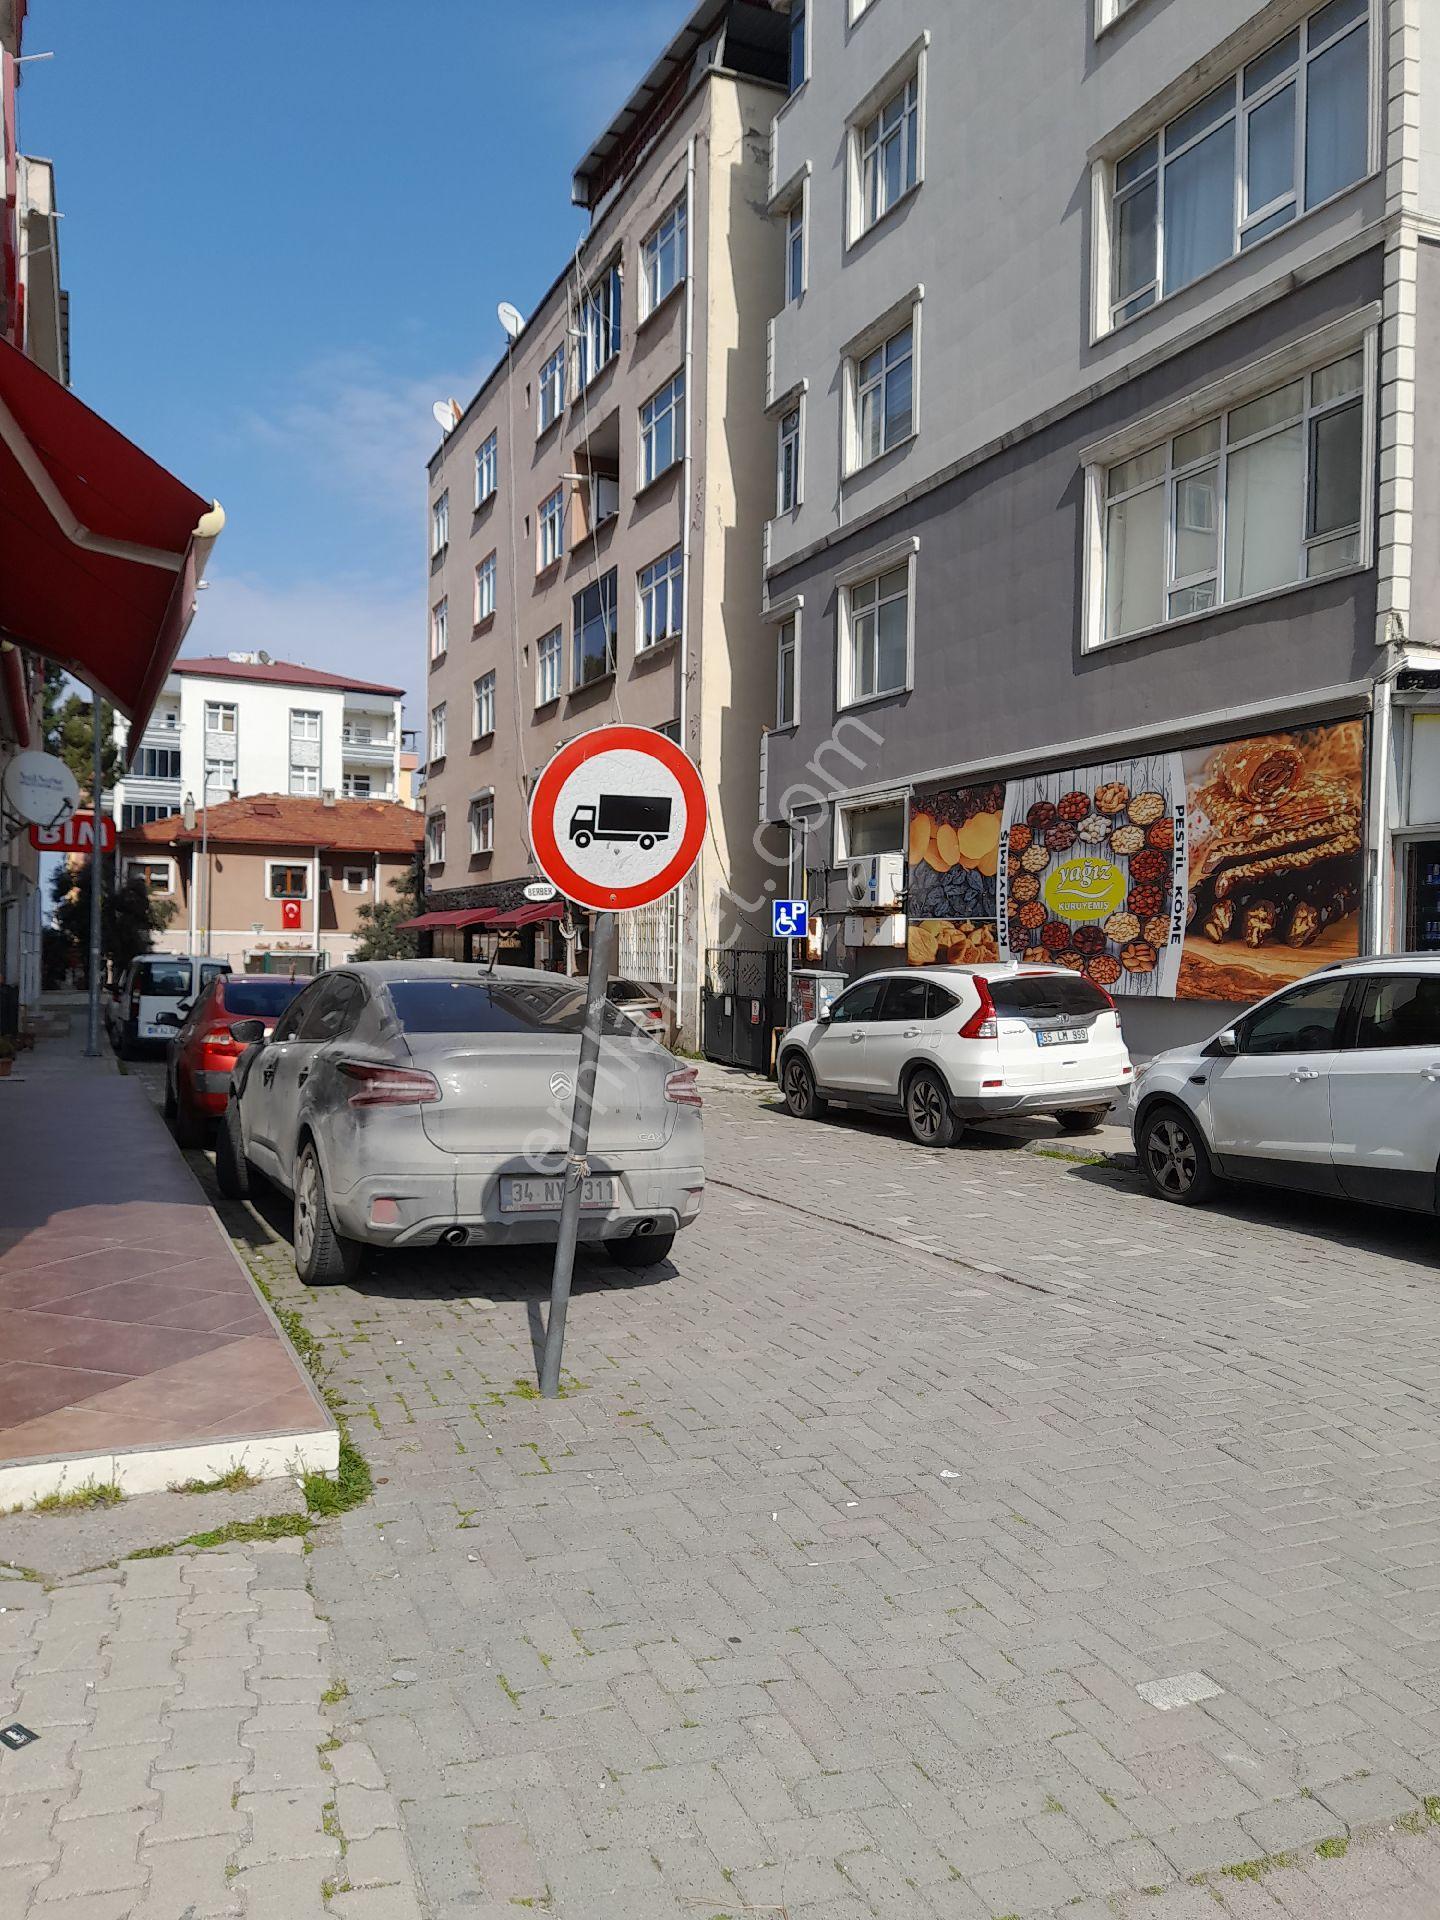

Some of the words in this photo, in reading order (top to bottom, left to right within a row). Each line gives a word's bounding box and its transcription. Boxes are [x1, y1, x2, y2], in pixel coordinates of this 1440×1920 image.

[1175, 804, 1187, 874] PESTİL
[1057, 859, 1113, 889] yağız
[527, 887, 553, 897] BERBER
[791, 902, 806, 921] P
[1171, 886, 1185, 945] KÖME
[1042, 1032, 1053, 1042] 55
[1058, 1030, 1068, 1041] LM
[513, 1182, 533, 1202] 34
[584, 1180, 612, 1201] 311
